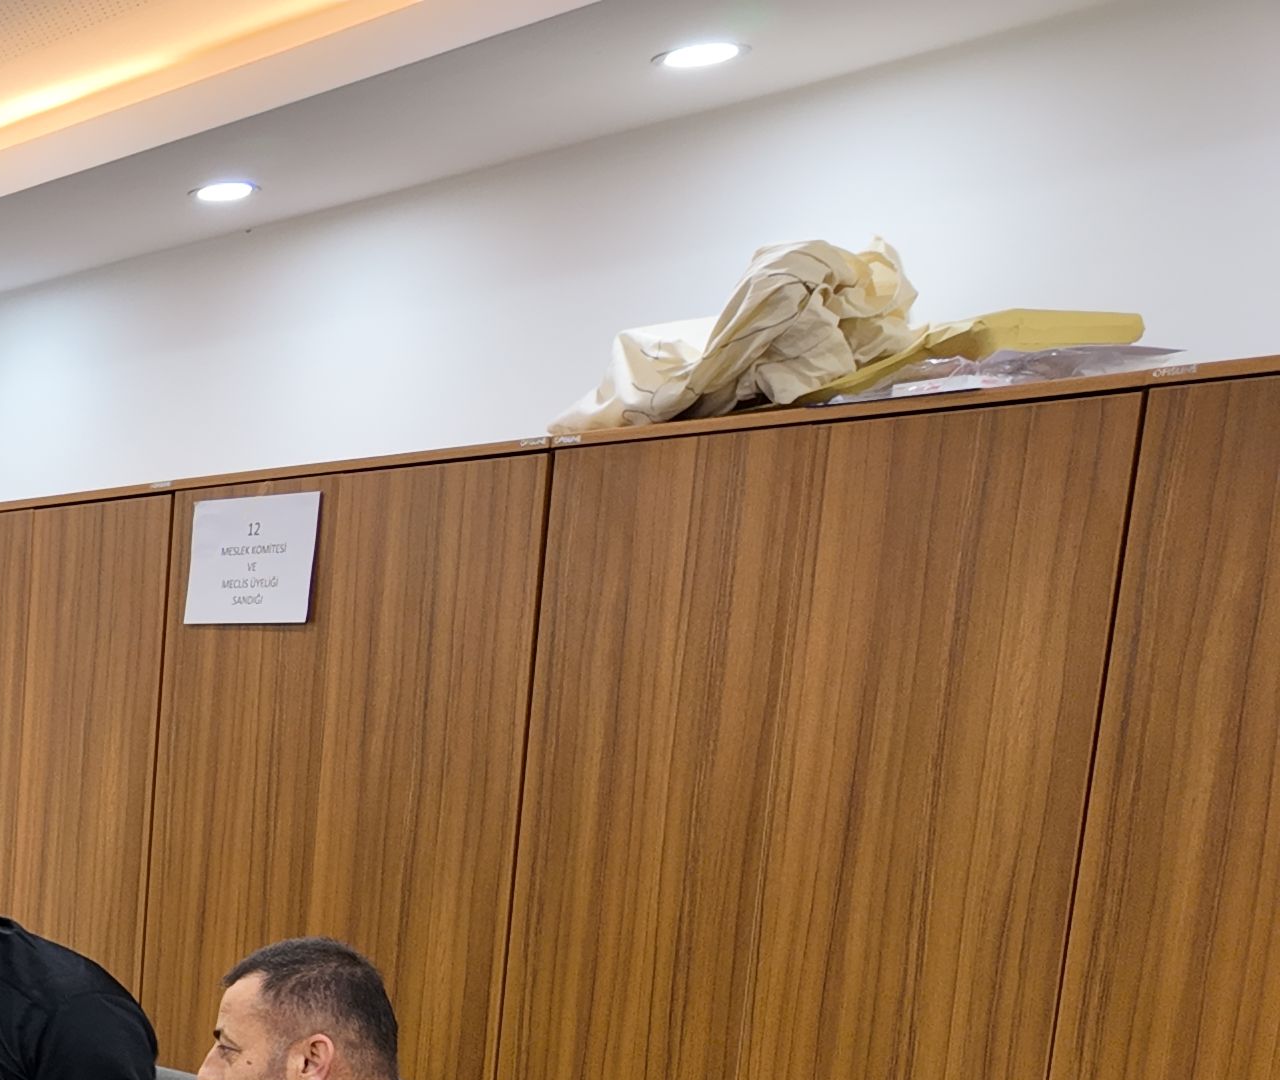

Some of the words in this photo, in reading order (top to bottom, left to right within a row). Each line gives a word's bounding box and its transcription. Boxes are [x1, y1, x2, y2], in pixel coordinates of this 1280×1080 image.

[248, 522, 261, 536] 12
[221, 546, 249, 556] MESLEK
[247, 562, 257, 571] VE
